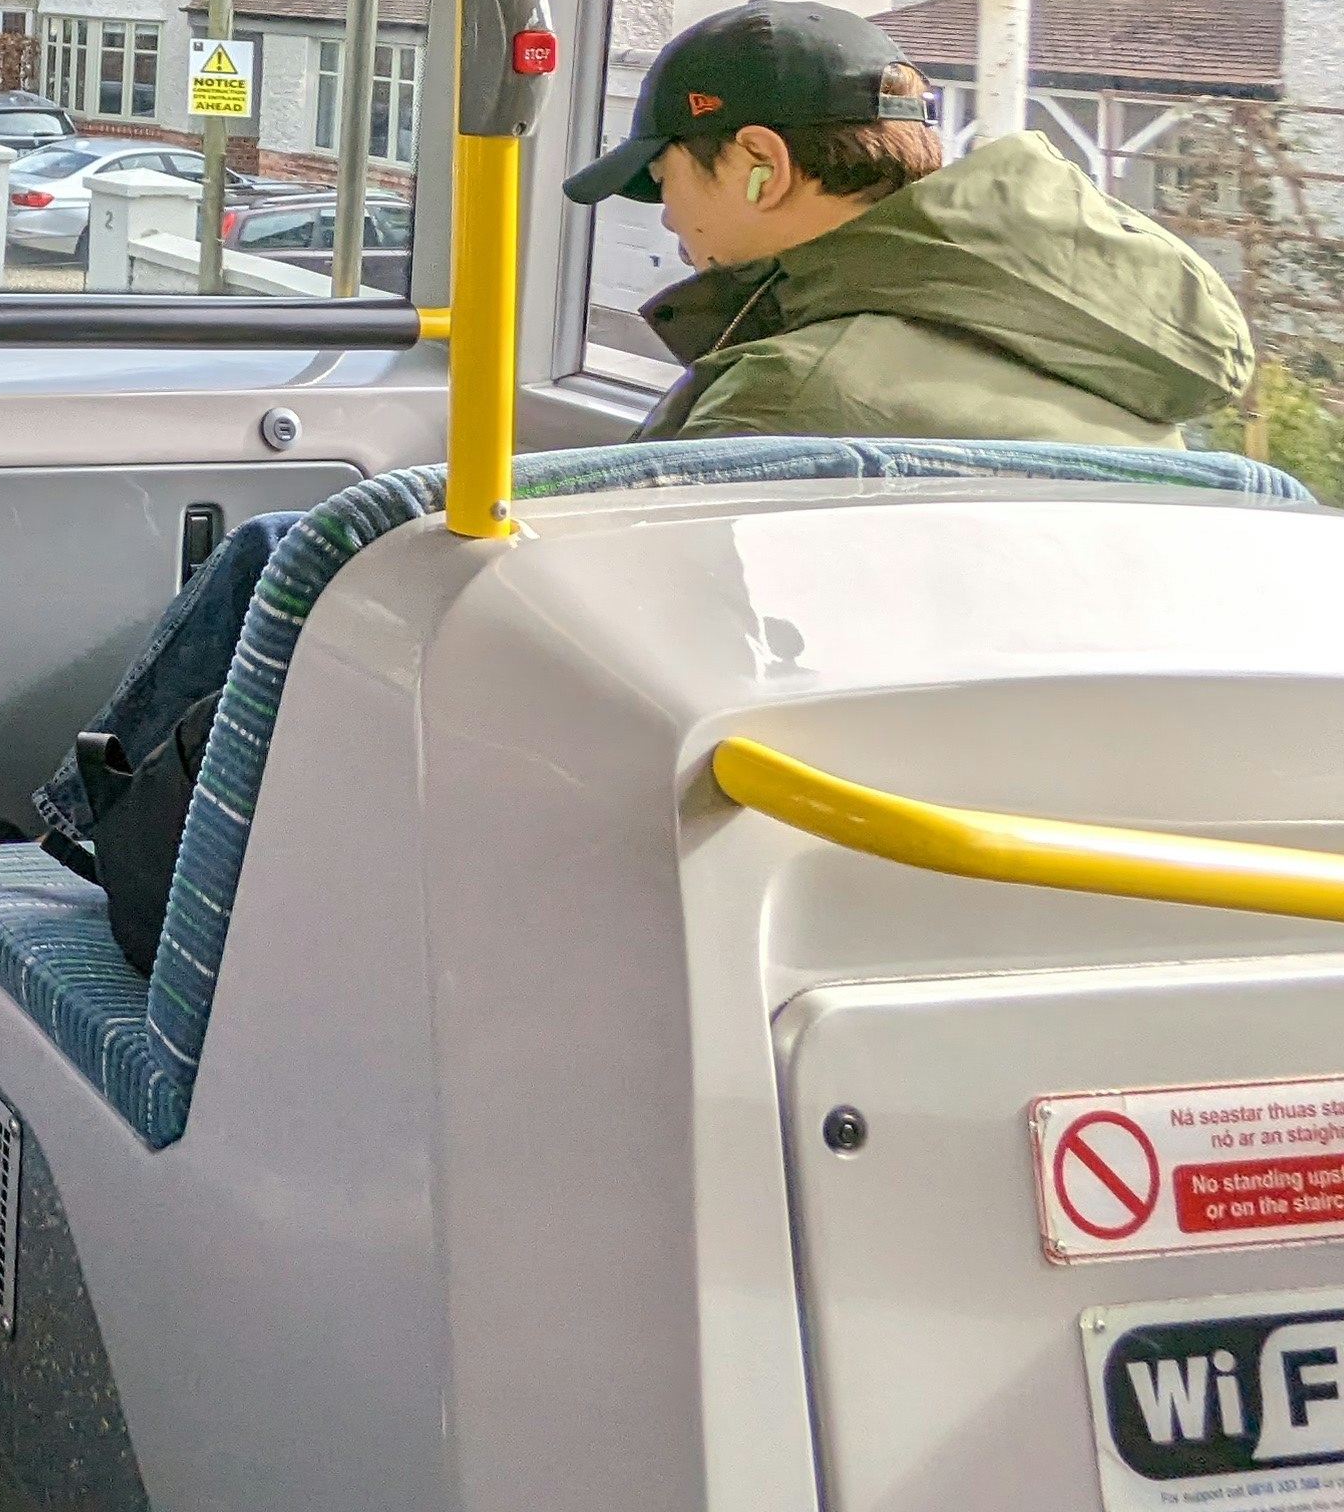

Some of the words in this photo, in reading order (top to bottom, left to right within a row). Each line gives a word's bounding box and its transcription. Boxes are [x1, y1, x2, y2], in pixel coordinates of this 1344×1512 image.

[525, 48, 551, 61] STOP
[193, 78, 246, 89] NOTICE
[195, 102, 242, 111] AHEAD
[105, 211, 113, 229] 2
[1170, 1106, 1195, 1127] Ná
[1199, 1107, 1263, 1125] seastar
[1268, 1102, 1317, 1119] thuas
[1211, 1129, 1234, 1148] nó
[1239, 1132, 1256, 1147] ar
[1261, 1130, 1283, 1146] an
[1192, 1174, 1219, 1194] No
[1223, 1168, 1304, 1191] standing
[1206, 1202, 1226, 1219] or
[1230, 1200, 1255, 1217] on
[1259, 1195, 1289, 1214] the
